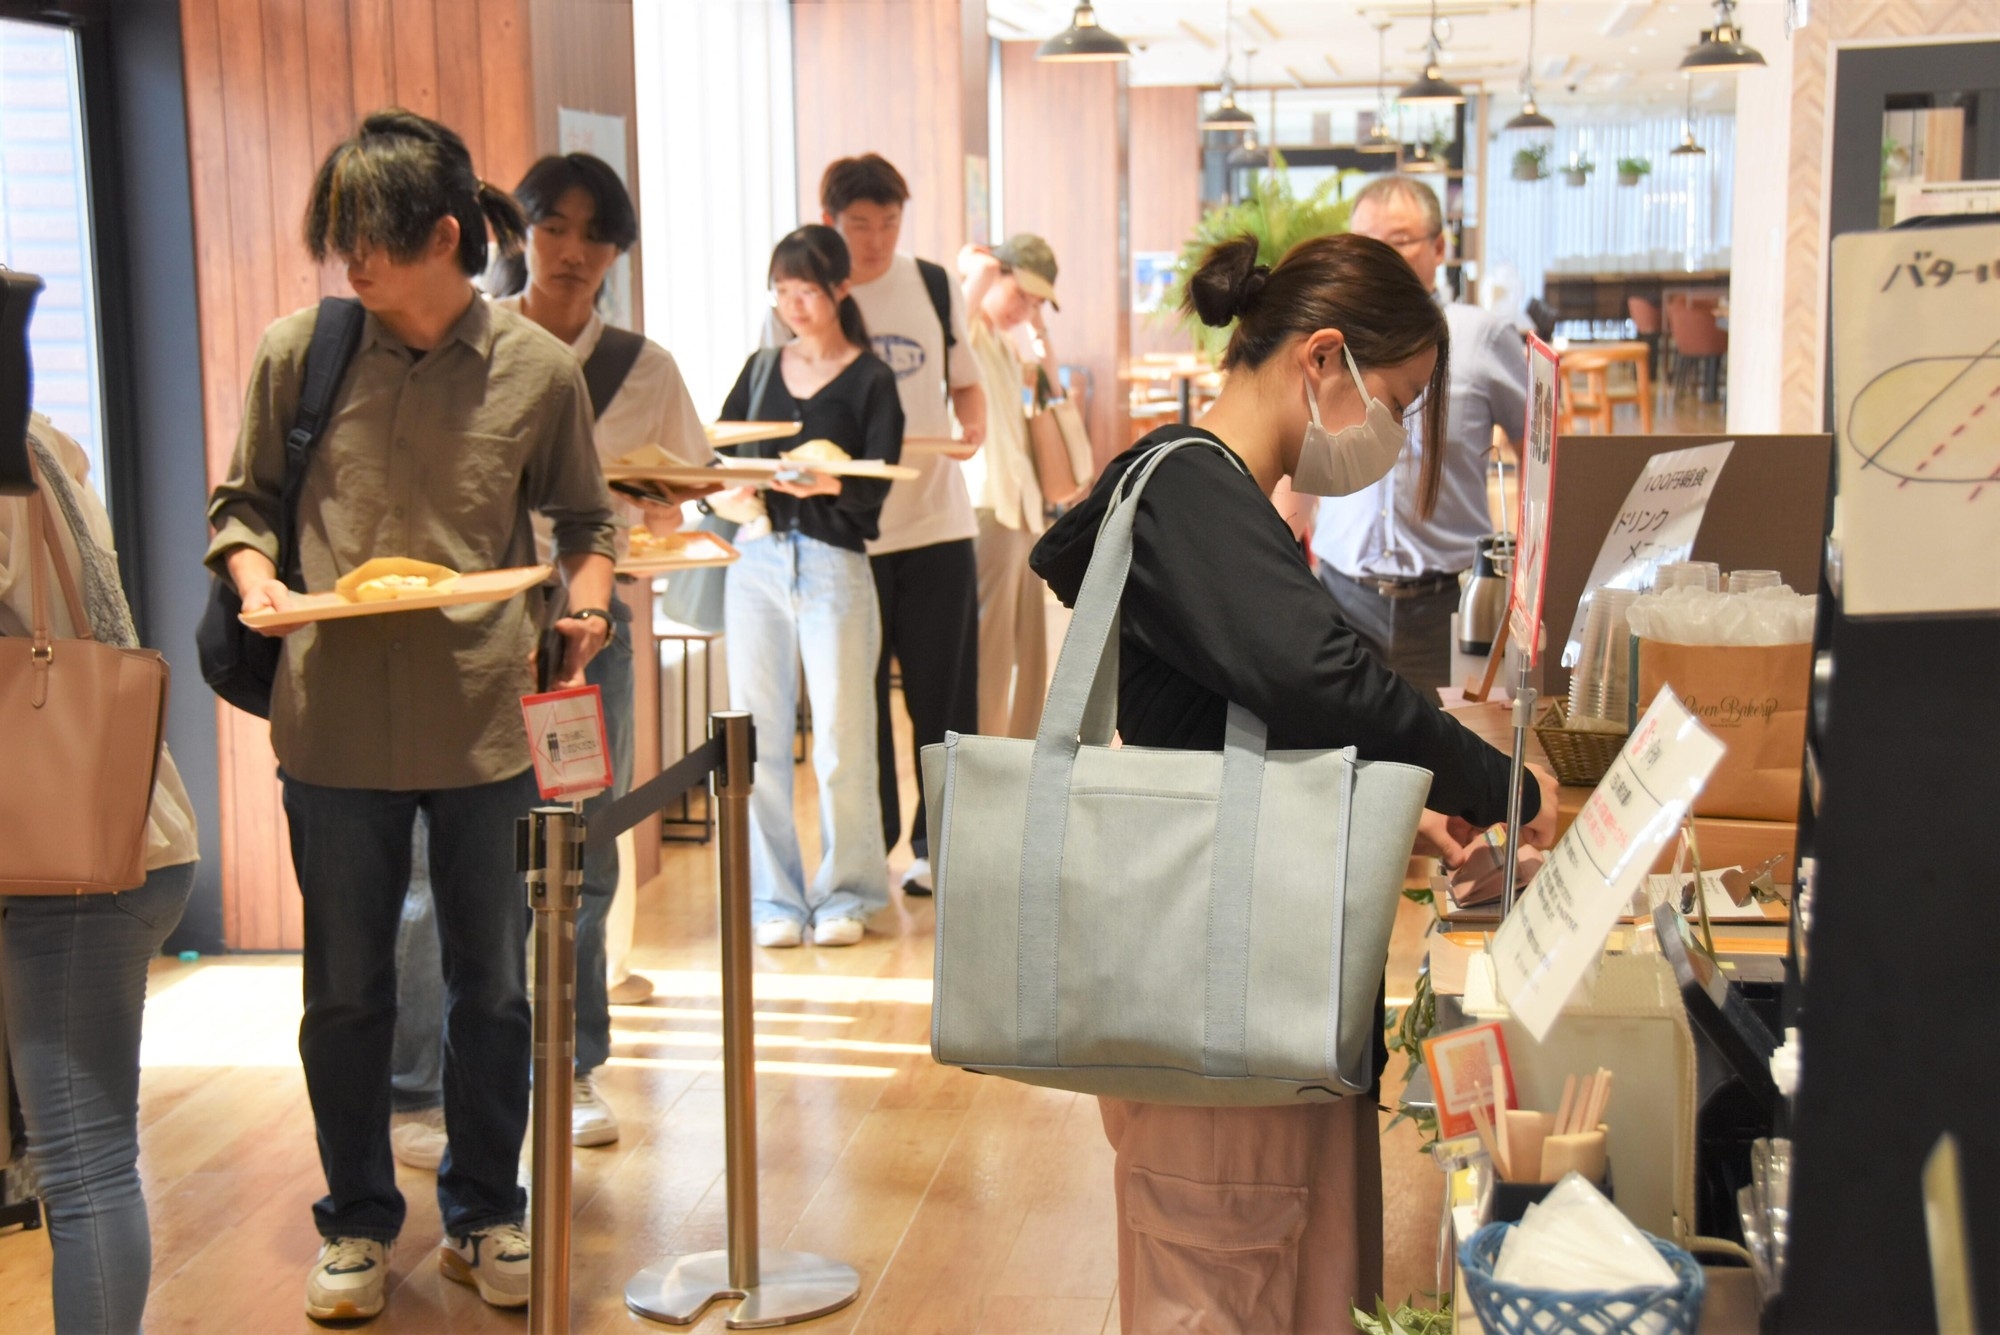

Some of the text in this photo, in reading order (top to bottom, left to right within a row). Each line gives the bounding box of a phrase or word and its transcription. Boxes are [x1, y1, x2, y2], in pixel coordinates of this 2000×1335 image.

[1613, 508, 1670, 535] ドリンク
[1720, 696, 1778, 725] Bakery
